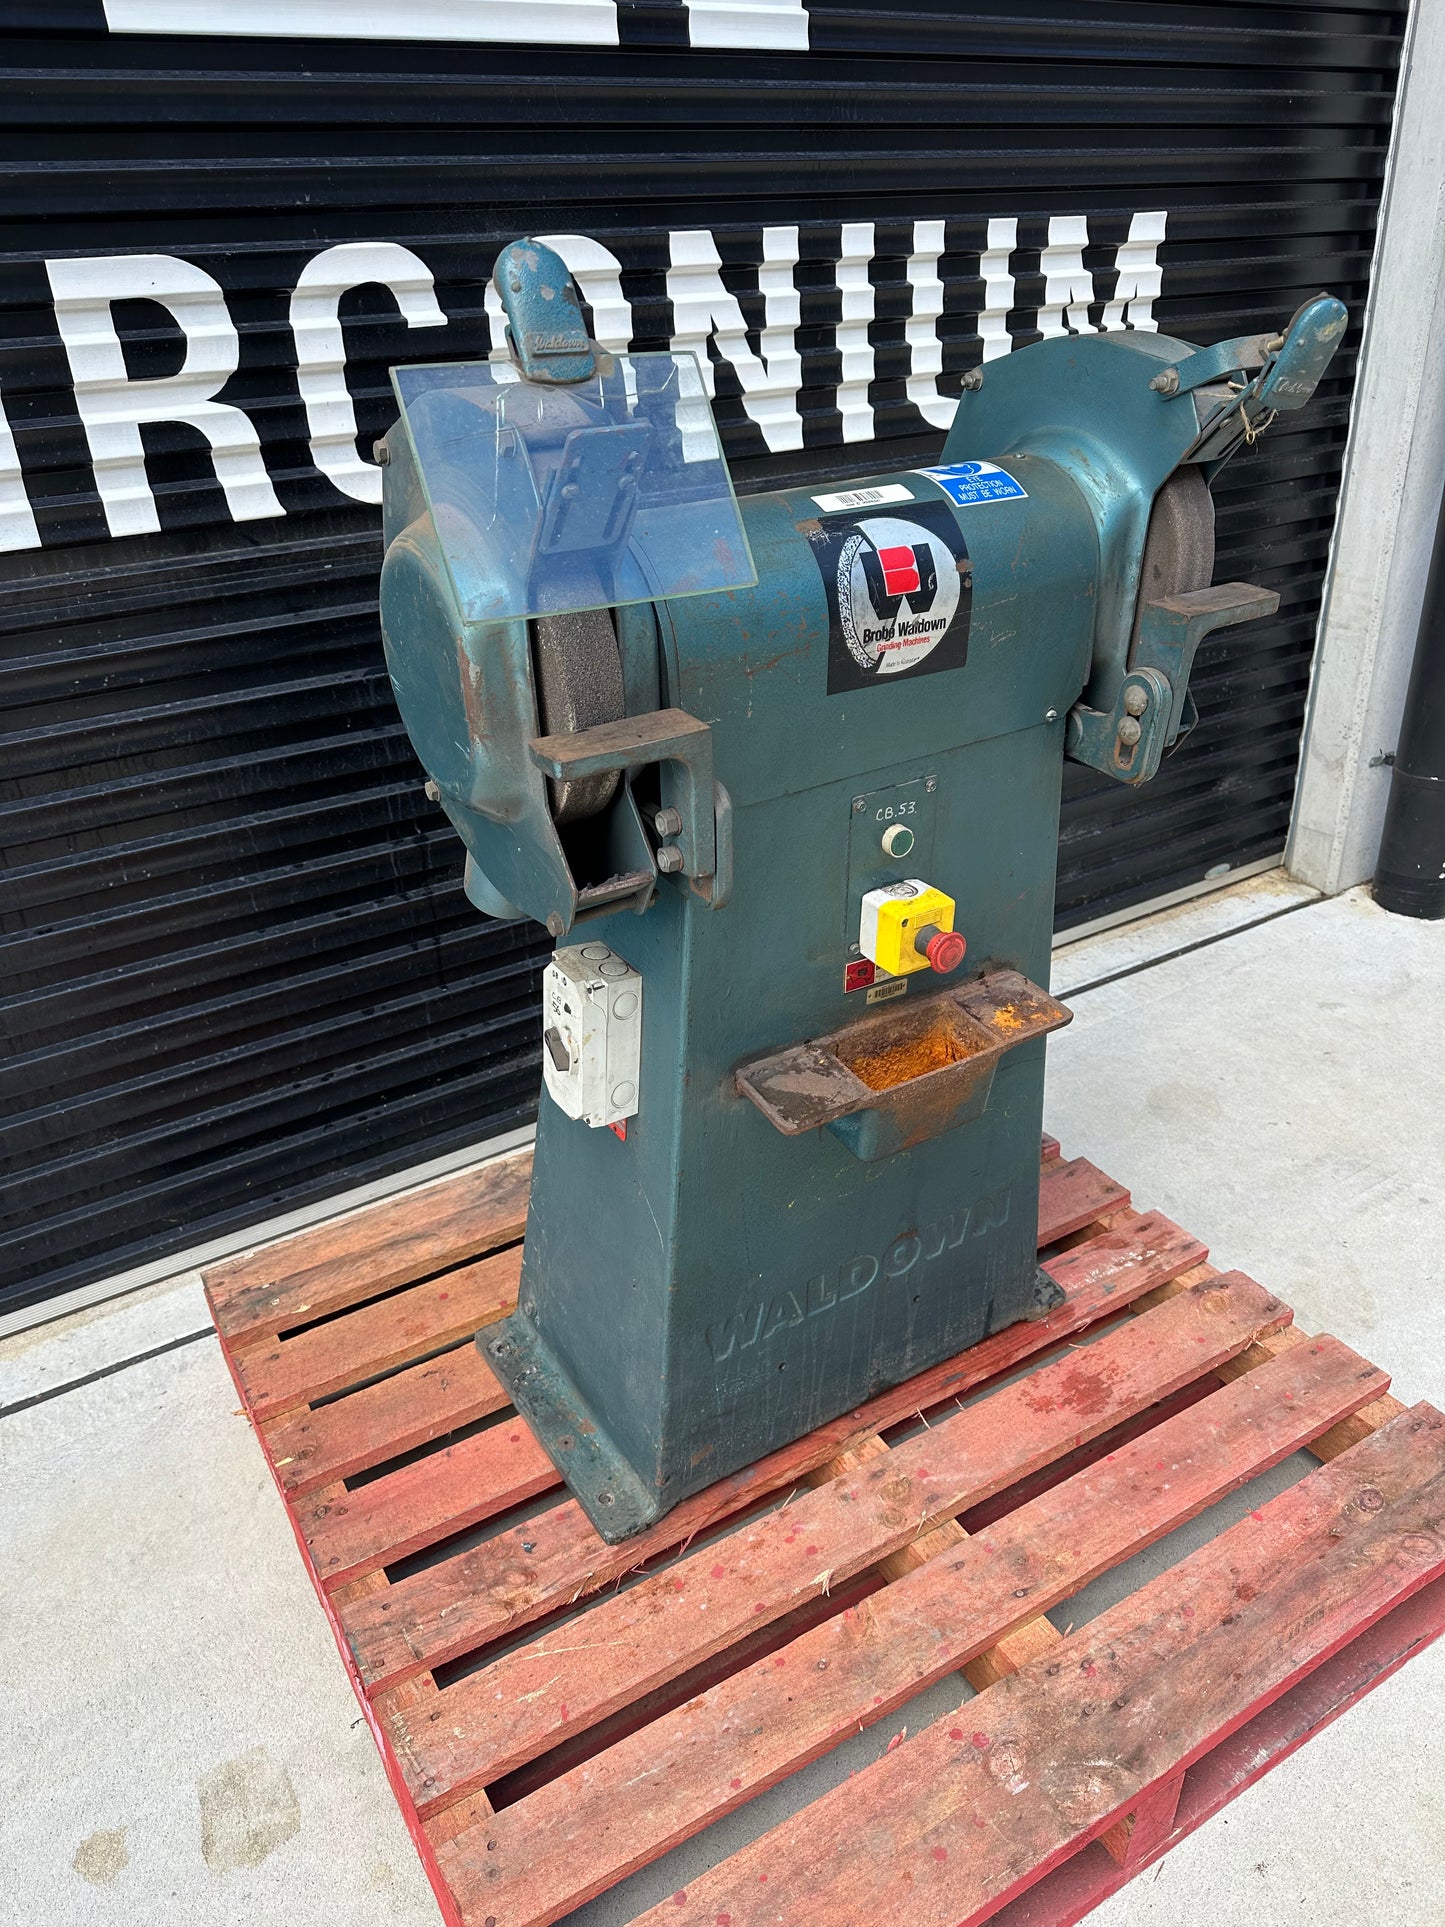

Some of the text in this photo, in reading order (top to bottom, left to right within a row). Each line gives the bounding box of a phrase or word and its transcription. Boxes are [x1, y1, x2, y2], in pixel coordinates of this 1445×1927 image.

[0, 210, 1168, 549] RCONIUM
[958, 480, 1004, 492] PROTECTION
[966, 475, 983, 483] EYE
[957, 486, 1018, 501] MUST BE WORN
[876, 635, 931, 653] Grinding Machines
[704, 1189, 1012, 1362] WALDOWN
